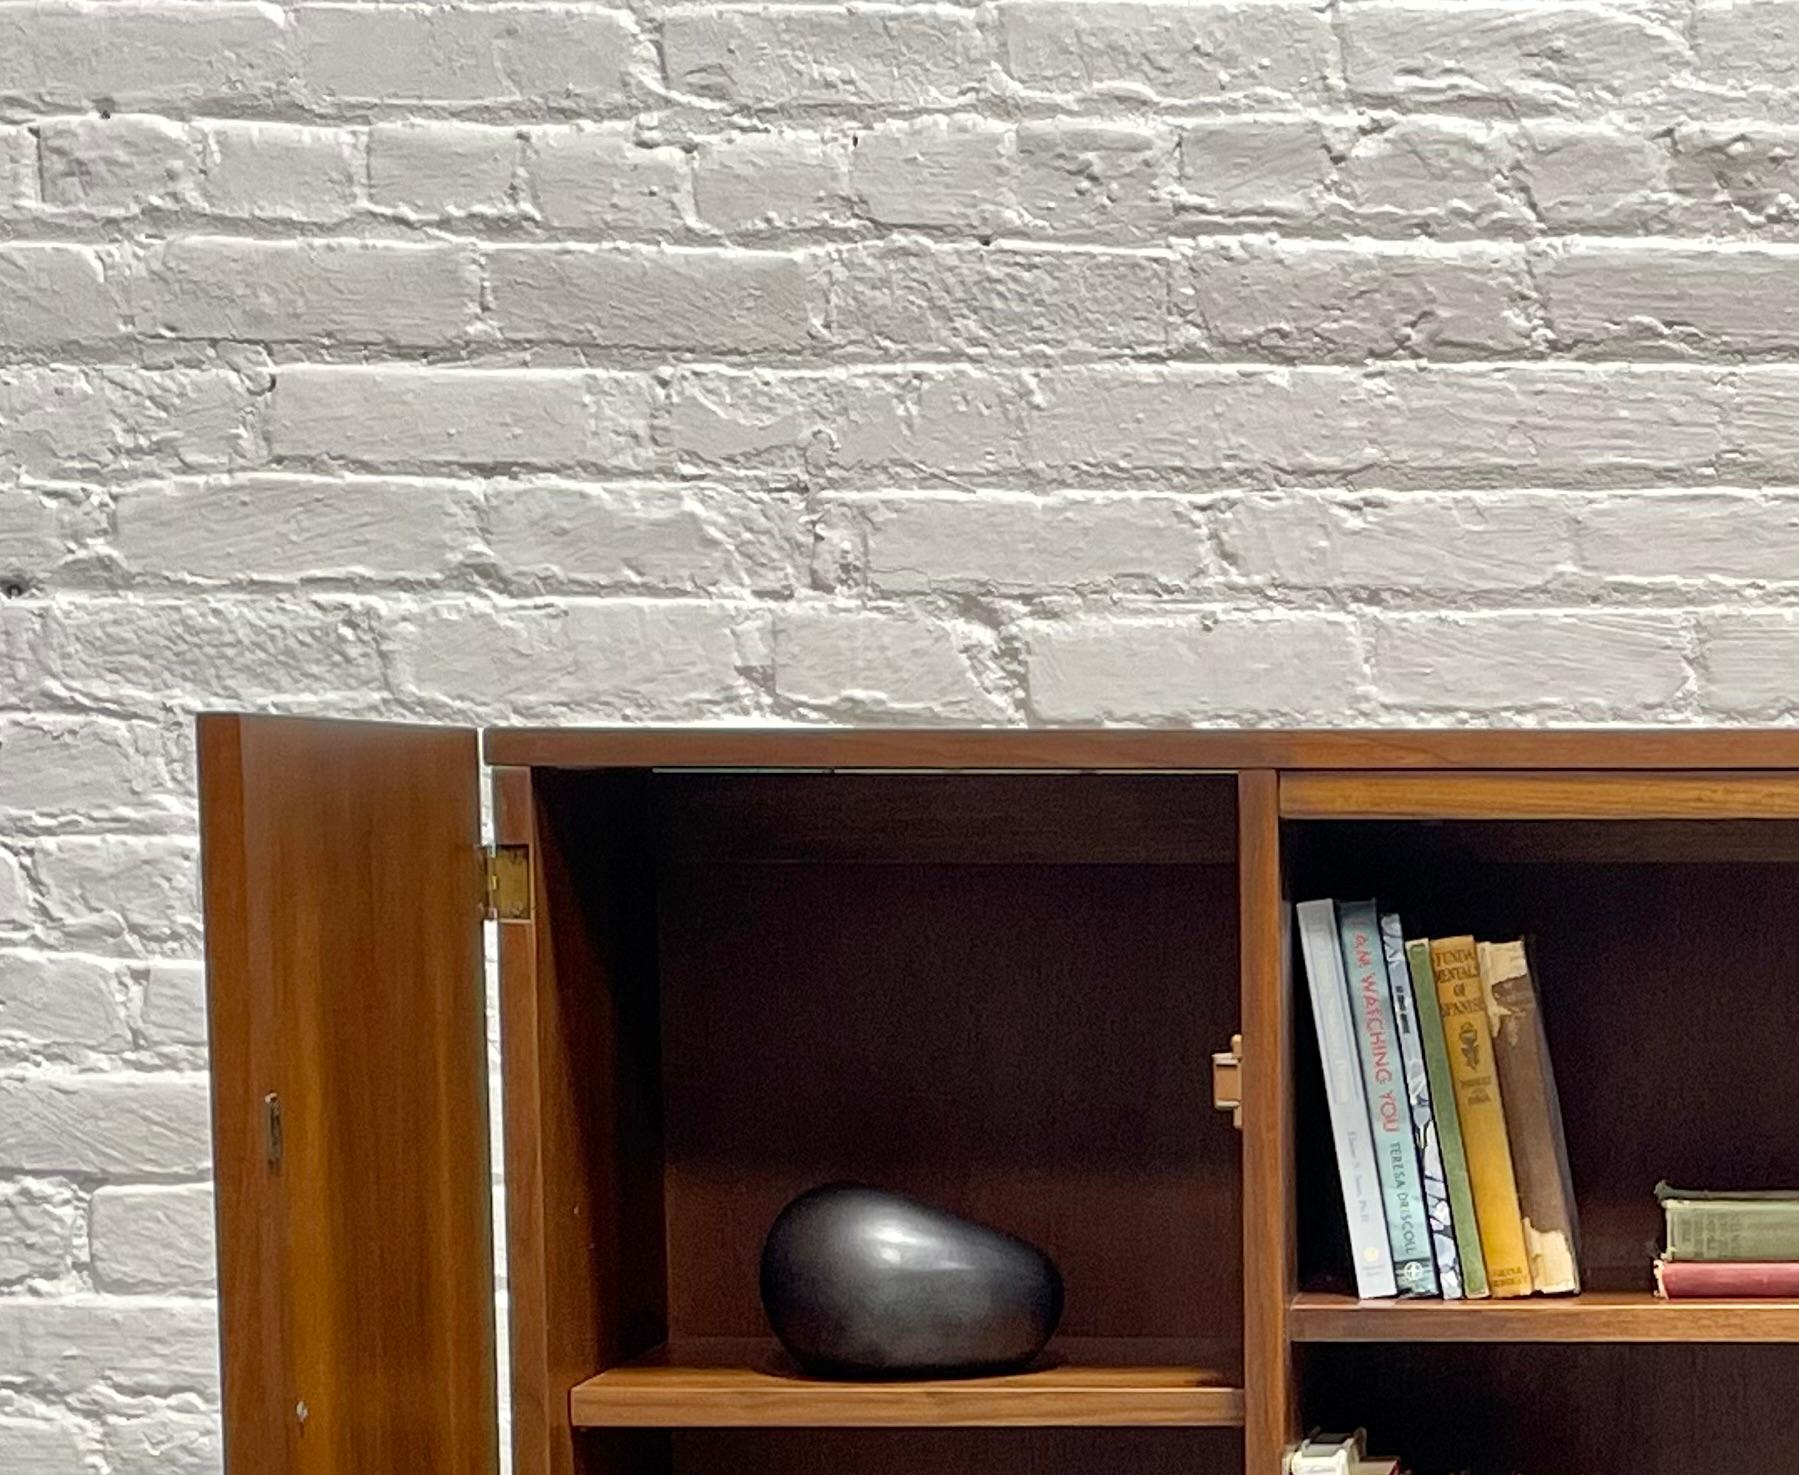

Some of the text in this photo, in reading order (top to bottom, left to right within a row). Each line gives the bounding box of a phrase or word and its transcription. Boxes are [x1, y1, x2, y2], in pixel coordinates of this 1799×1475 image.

[1354, 932, 1373, 968] AM
[1360, 972, 1393, 1085] WATCHING
[1377, 1090, 1399, 1133] YOU
[1389, 1142, 1406, 1189] TERESA
